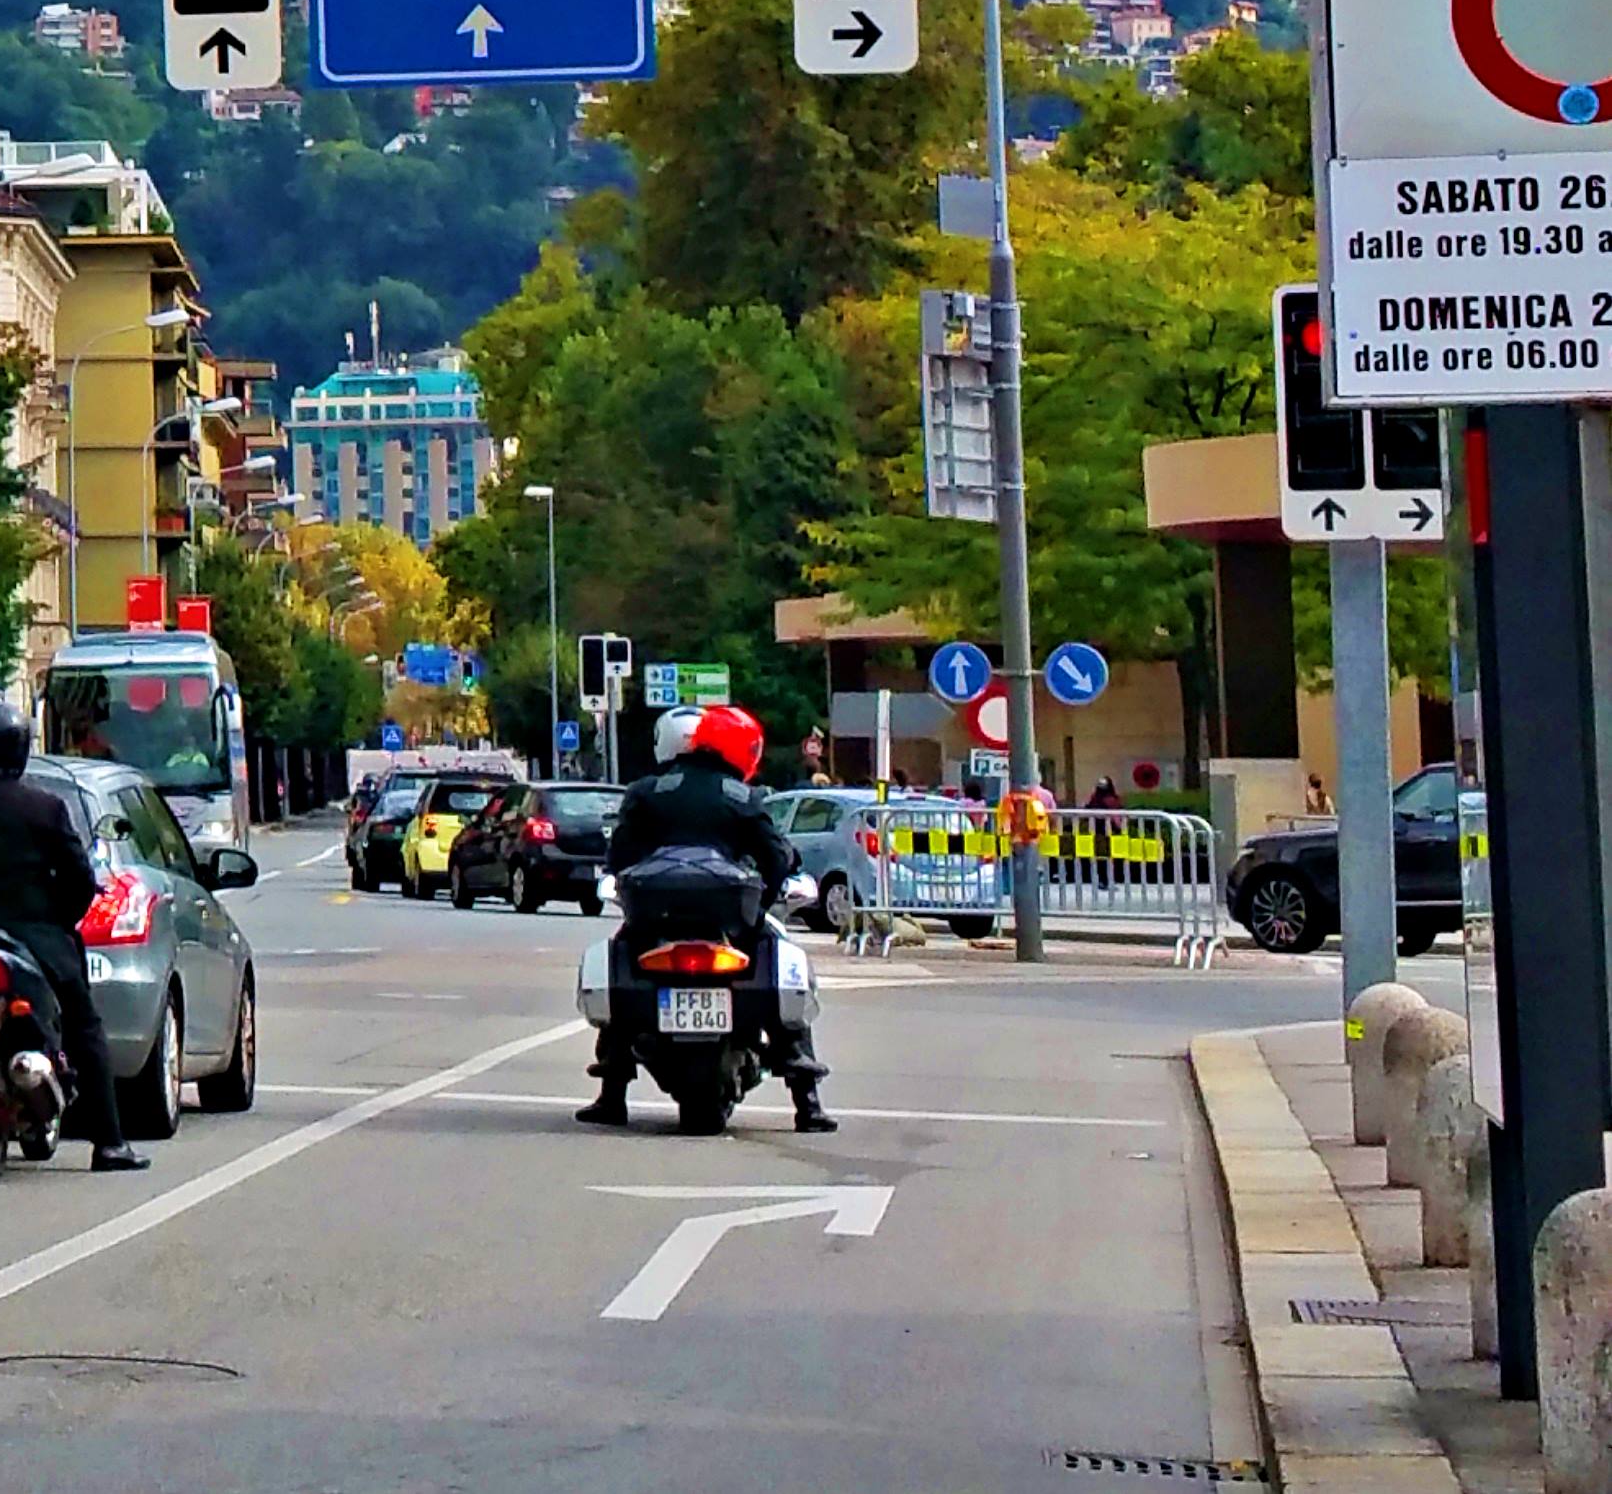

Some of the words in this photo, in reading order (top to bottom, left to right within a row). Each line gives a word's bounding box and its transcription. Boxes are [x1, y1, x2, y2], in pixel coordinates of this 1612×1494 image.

[1396, 176, 1540, 215] SABATO
[1560, 174, 1612, 210] 26
[1348, 229, 1423, 260] dalle
[1436, 234, 1487, 258] ore
[1499, 224, 1584, 256] 19.30
[1378, 293, 1573, 331] DOMENICA
[1354, 343, 1429, 373] dalle
[1442, 346, 1493, 370] ore
[1506, 338, 1599, 370] 06.00
[91, 956, 102, 979] H
[675, 991, 713, 1009] FFB
[692, 1011, 727, 1029] 840
